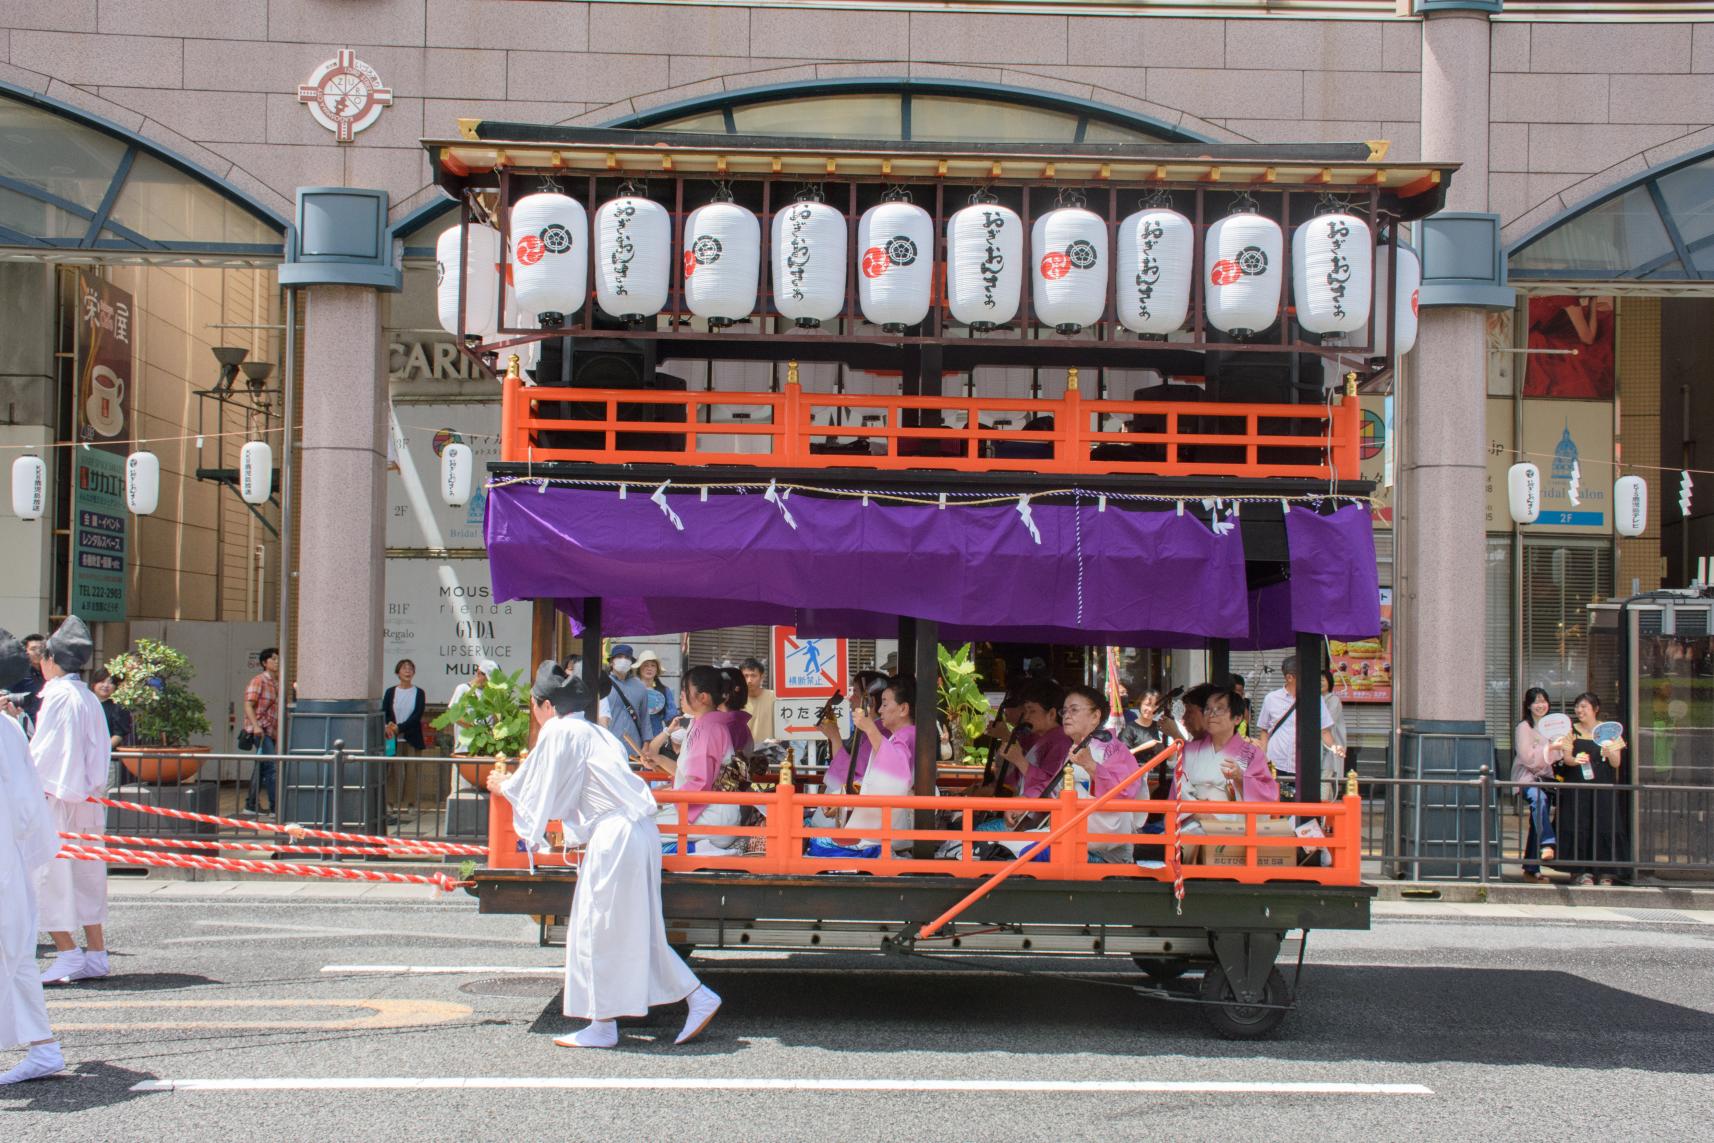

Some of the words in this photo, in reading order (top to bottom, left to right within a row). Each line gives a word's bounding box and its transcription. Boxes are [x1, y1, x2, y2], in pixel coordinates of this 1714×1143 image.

[394, 505, 409, 517] 2F
[1560, 513, 1573, 523] 2F
[439, 586, 492, 598] MOUS
[389, 603, 410, 615] B1F
[439, 604, 513, 615] rienda
[383, 628, 415, 640] Regalo
[456, 620, 495, 639] GYDA
[446, 663, 502, 675] MUR
[789, 676, 823, 686] 横断禁止
